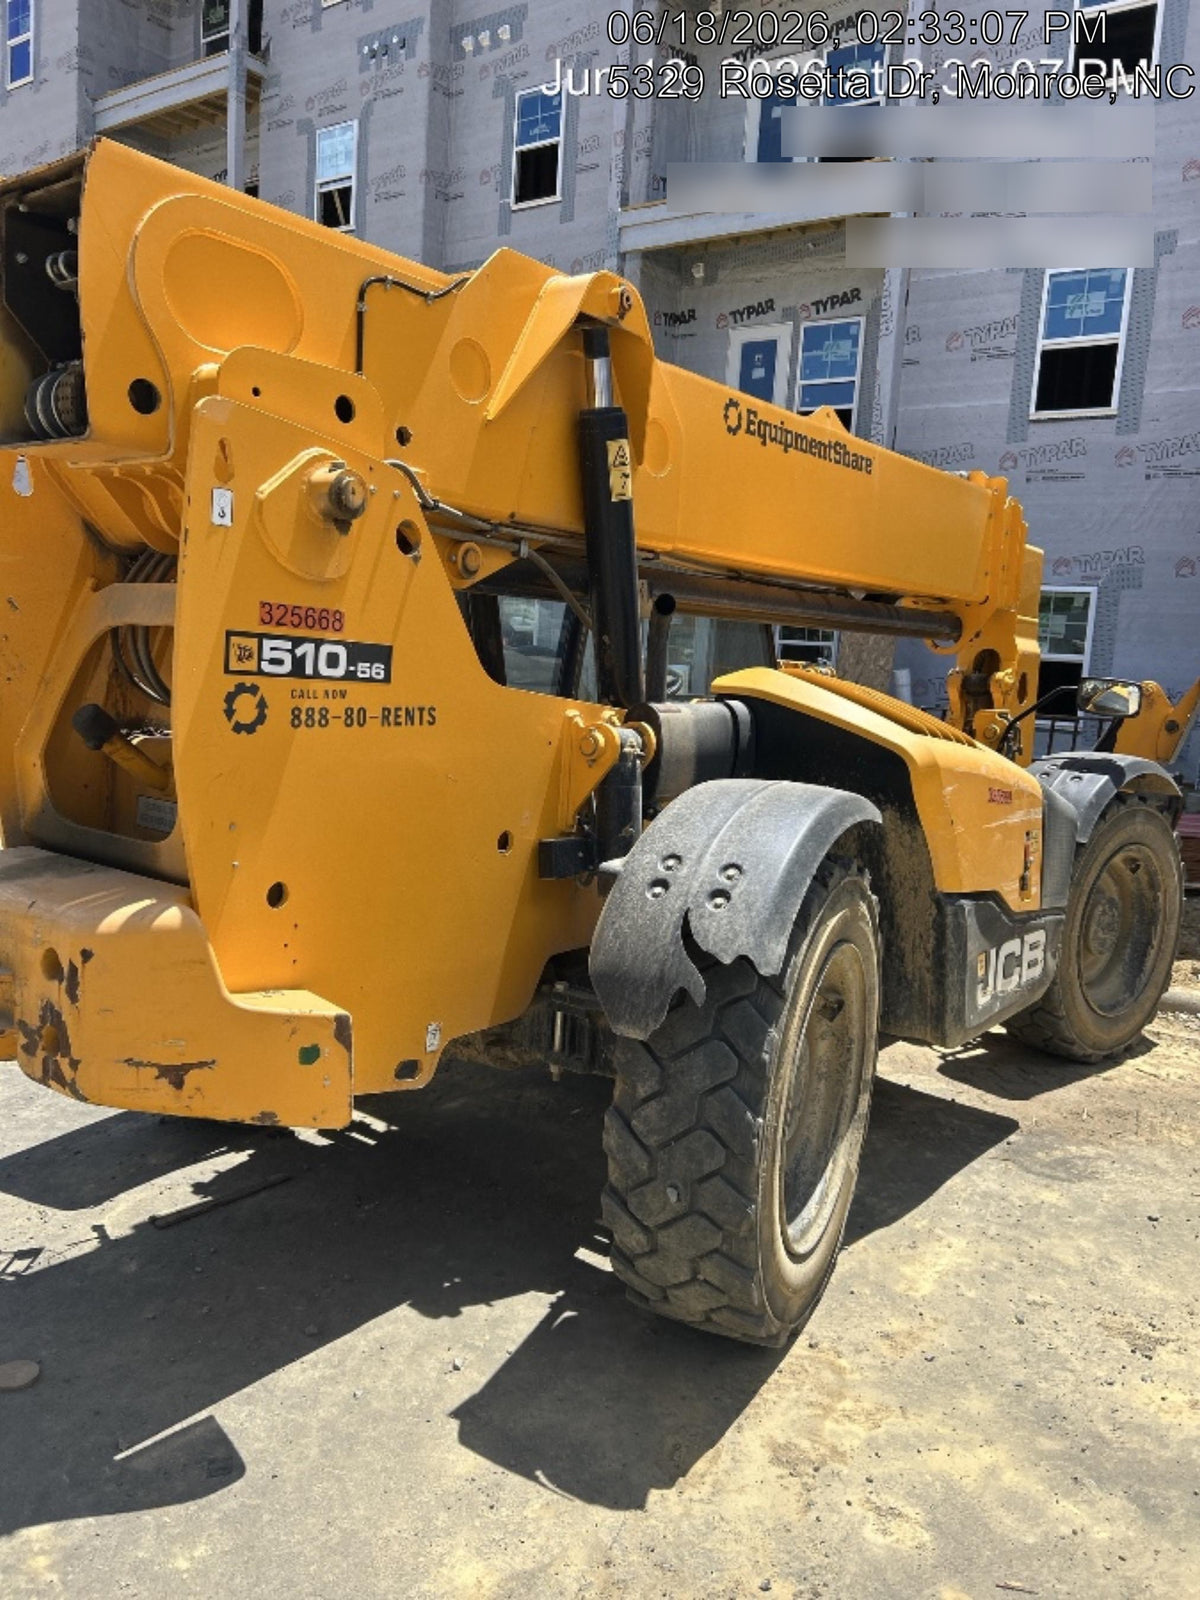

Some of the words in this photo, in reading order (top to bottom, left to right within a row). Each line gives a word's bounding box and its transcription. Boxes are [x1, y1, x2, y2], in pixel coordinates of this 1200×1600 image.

[729, 298, 776, 325] TYPAR
[811, 287, 862, 316] TYPAR
[963, 314, 1020, 347] TYPA
[745, 408, 873, 475] EquipmentShare
[1019, 437, 1088, 468] TYPAR
[1136, 431, 1200, 463] TYPA
[1073, 545, 1145, 575] TYPAR
[260, 602, 345, 632] 325668
[291, 689, 319, 700] CALL
[324, 689, 348, 700] NOW
[290, 705, 437, 729] 888-80-RENTS
[976, 929, 1047, 1011] JCB
